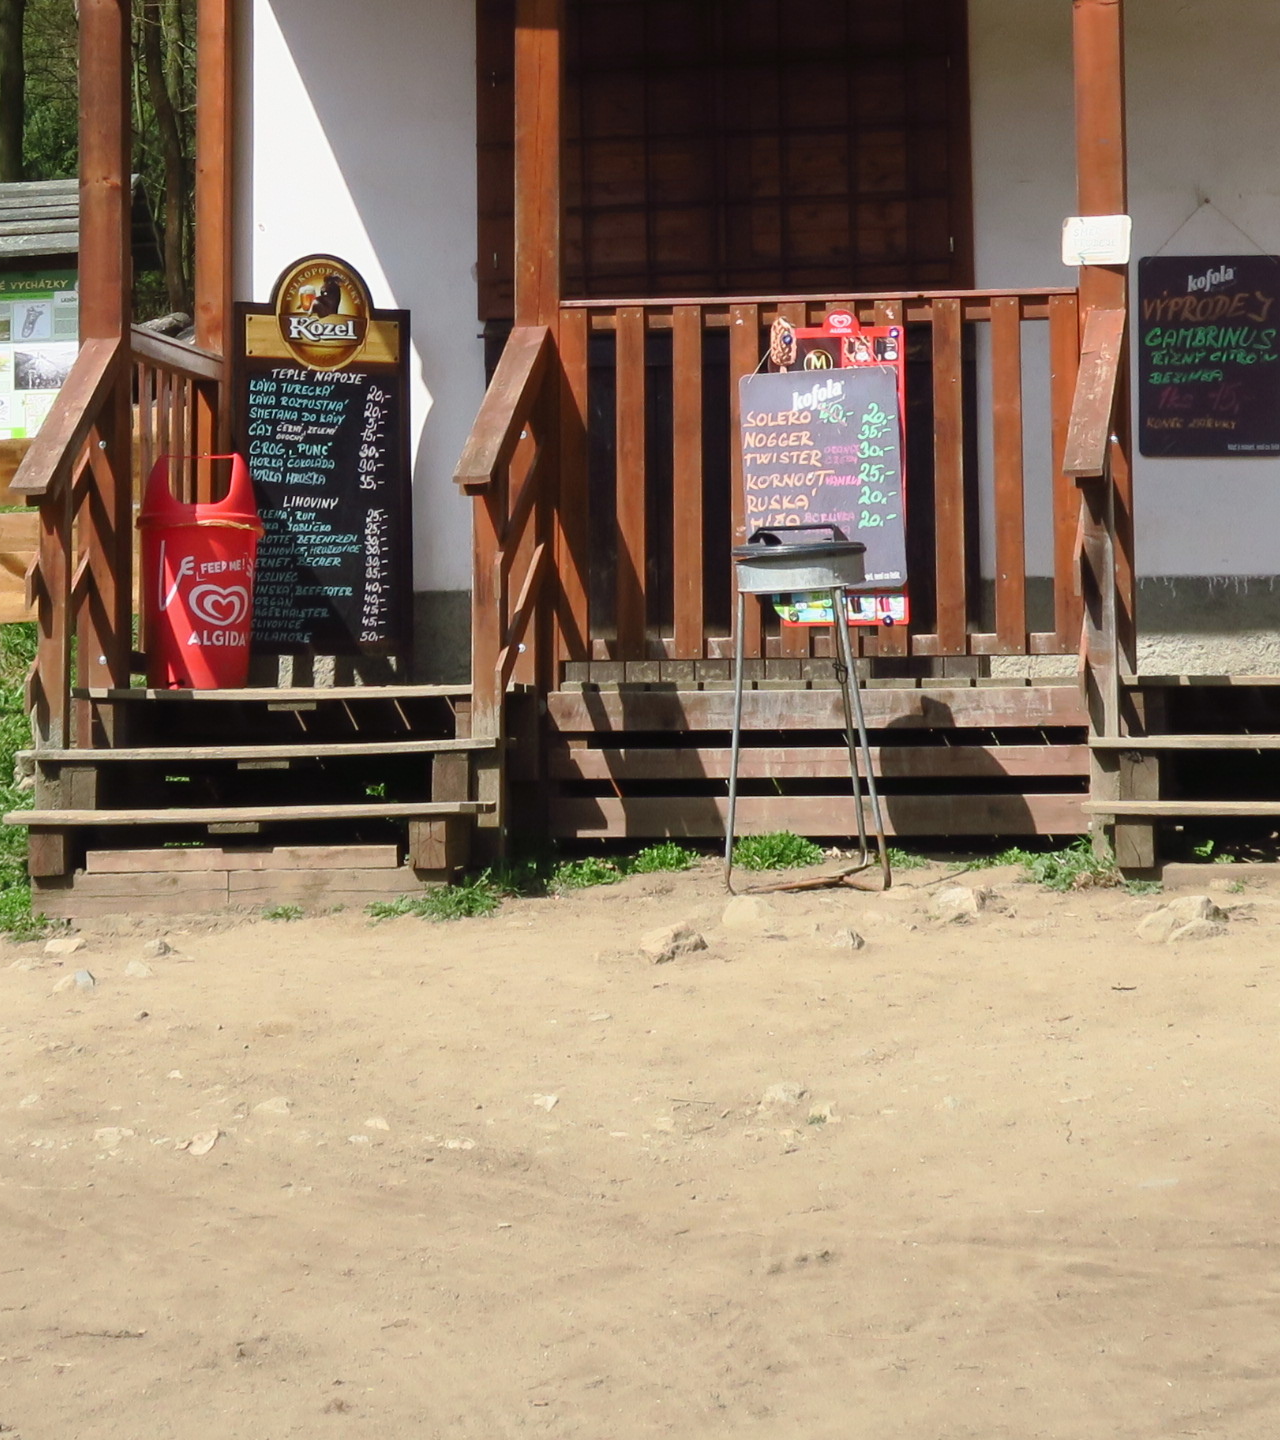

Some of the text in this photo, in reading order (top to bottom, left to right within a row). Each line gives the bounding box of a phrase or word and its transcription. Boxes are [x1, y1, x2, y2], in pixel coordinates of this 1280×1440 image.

[10, 278, 69, 290] VYCHÁZKY
[1187, 265, 1234, 292] kofola
[1143, 290, 1274, 322] VÝPRODEJ
[289, 317, 357, 342] Kozel
[1144, 325, 1276, 349] GAMBRINUS
[271, 366, 312, 382] TEPLÉ
[249, 378, 276, 392] KÁVA
[281, 383, 335, 397] TURECKÁ
[793, 378, 842, 410] kofola
[249, 393, 276, 406] KÁVA
[249, 407, 298, 421] SMETANA
[302, 411, 316, 422] DO
[743, 411, 812, 427] SOLERO
[743, 431, 814, 450] NOGGER
[744, 451, 822, 467] TWISTER
[283, 495, 339, 510] LIHOVINY
[747, 488, 817, 514] RUSKÁ
[200, 558, 245, 574] FEED ME!
[253, 571, 298, 582] YSLIVEC
[252, 597, 293, 607] ORGAN
[187, 630, 246, 646] ALGIDA
